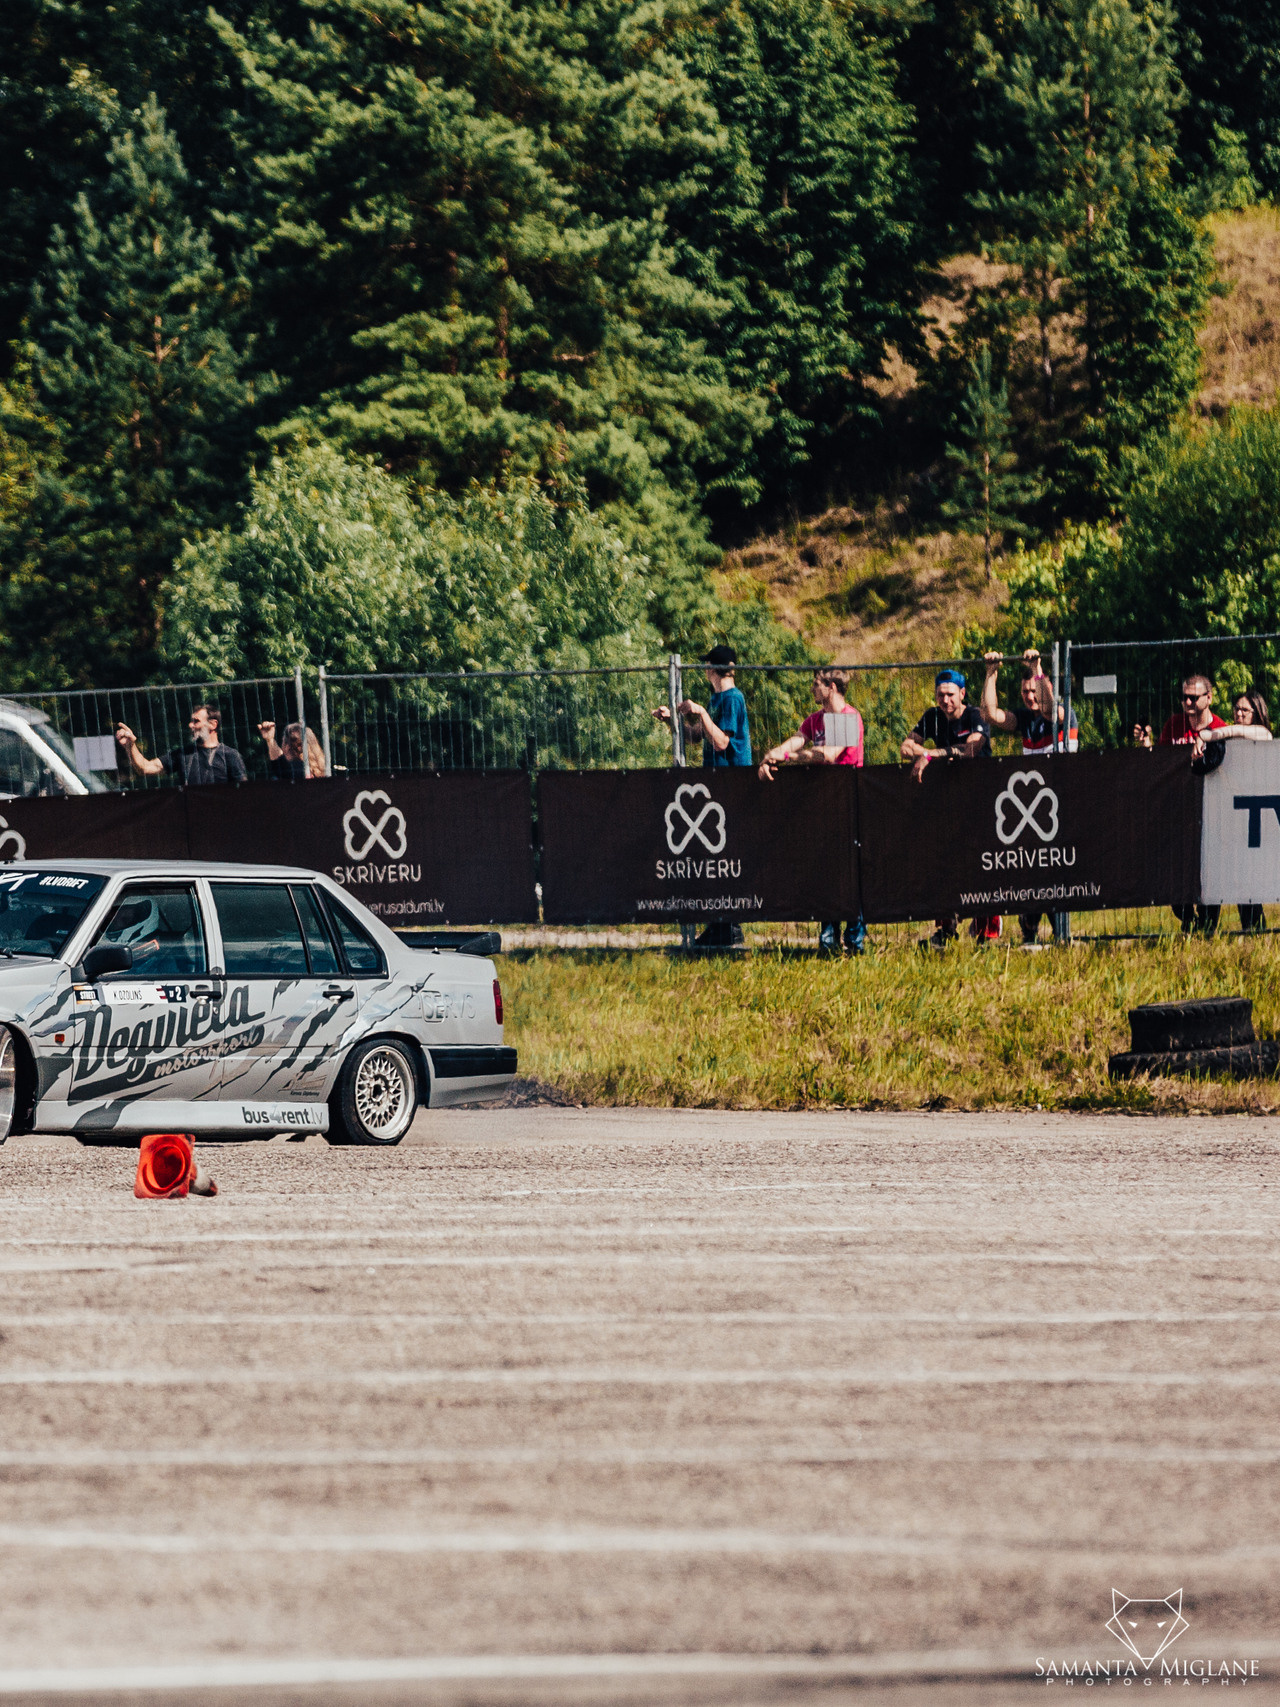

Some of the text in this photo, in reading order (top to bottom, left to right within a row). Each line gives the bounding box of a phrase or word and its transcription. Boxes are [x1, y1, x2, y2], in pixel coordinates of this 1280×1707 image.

[1233, 795, 1280, 848] T
[39, 875, 90, 889] #LVDRIFT
[960, 881, 1101, 904] www.skriverusaldumi.lv
[364, 899, 445, 915] verusaldumi.lv
